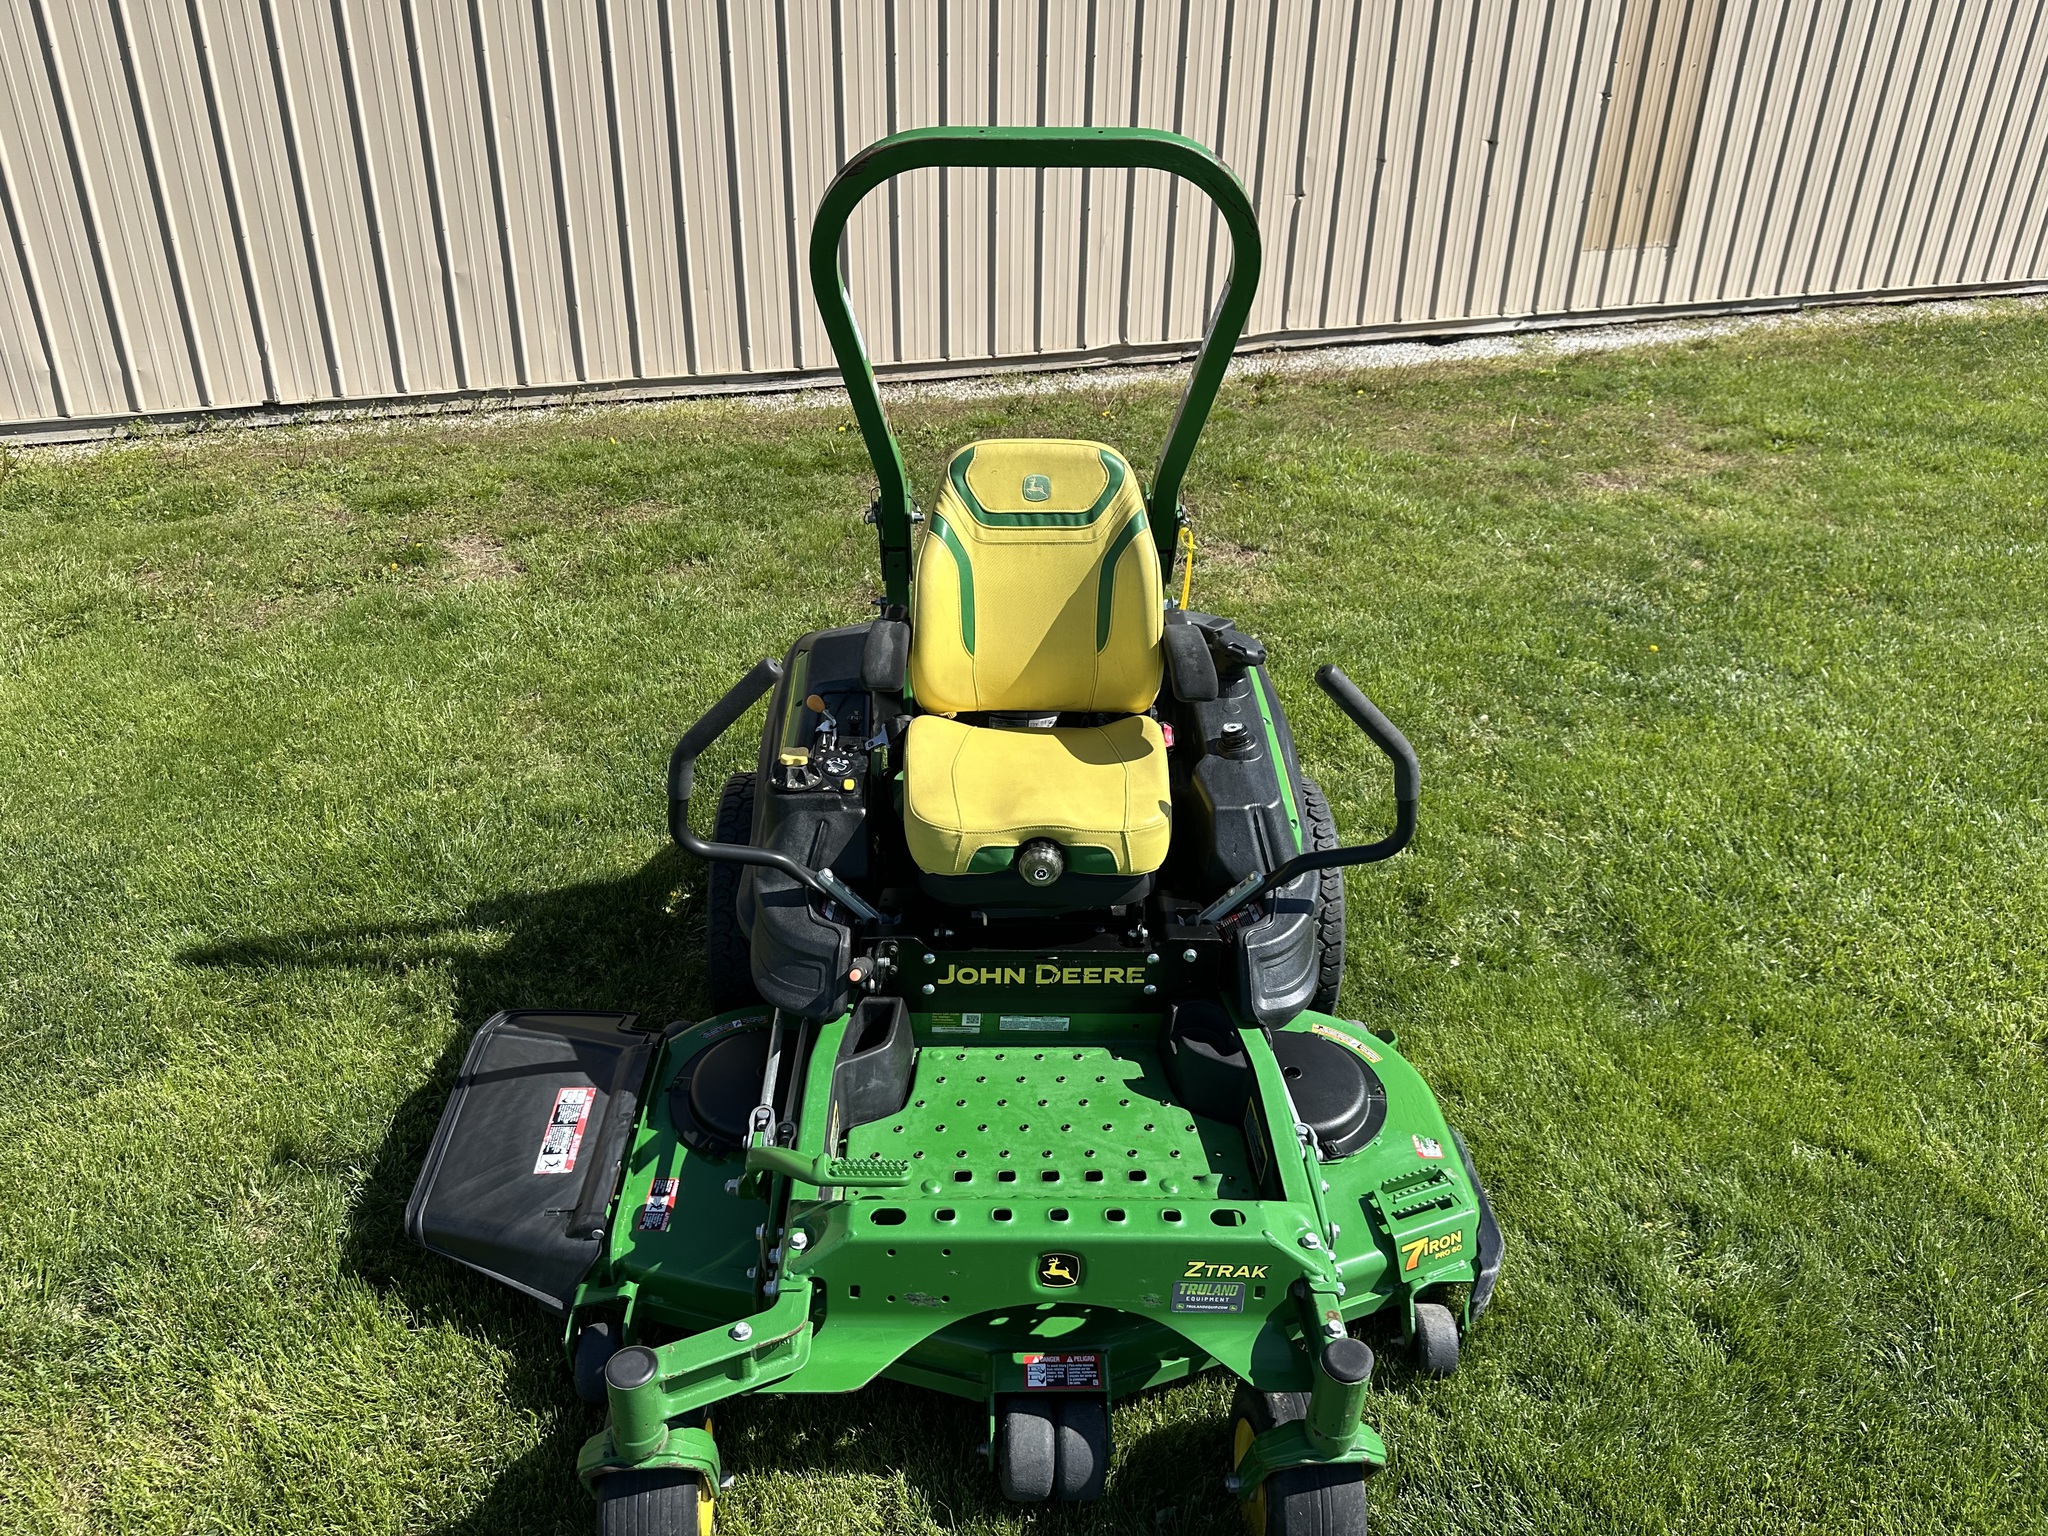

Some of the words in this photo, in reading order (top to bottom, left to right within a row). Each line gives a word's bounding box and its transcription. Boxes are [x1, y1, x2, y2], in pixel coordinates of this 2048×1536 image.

[938, 965, 1025, 985] JOHN
[1036, 964, 1145, 984] DEERE
[1435, 1249, 1451, 1260] PRO
[1183, 1261, 1269, 1279] ZTRAK
[1179, 1283, 1239, 1297] TRULAND
